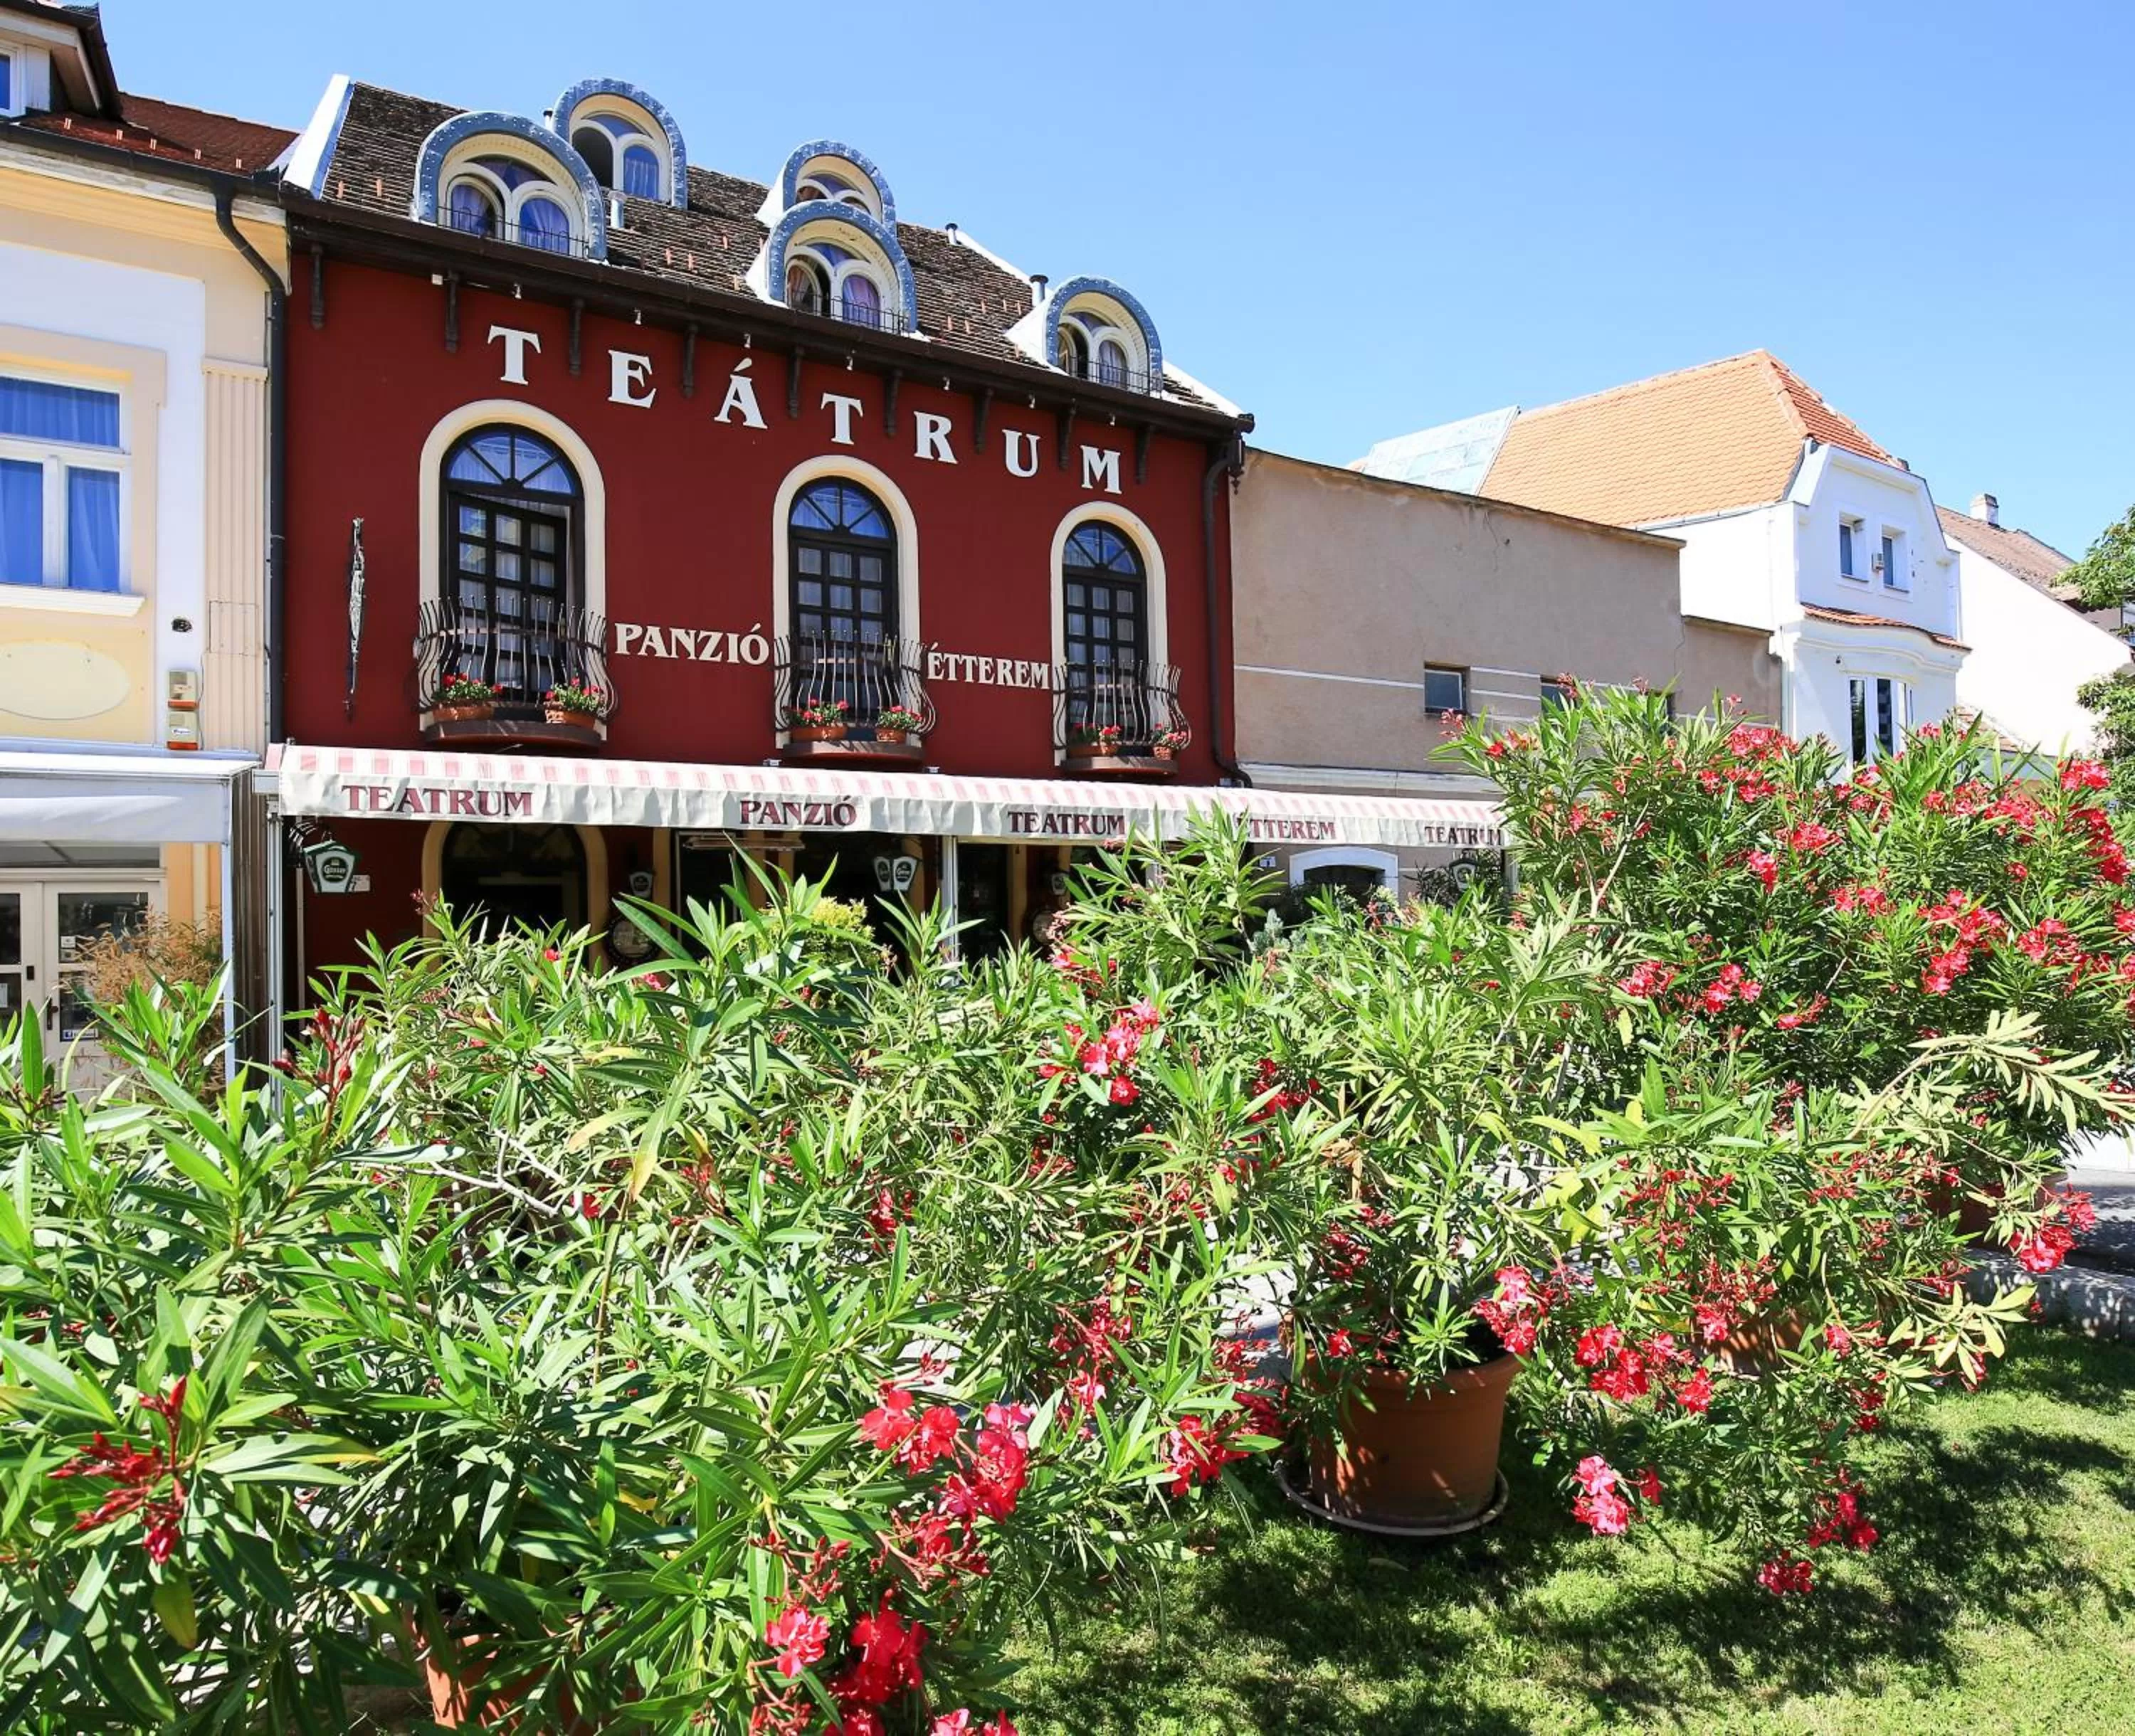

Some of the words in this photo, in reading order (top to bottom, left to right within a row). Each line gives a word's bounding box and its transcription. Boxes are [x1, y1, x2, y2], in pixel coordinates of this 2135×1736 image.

[487, 324, 1122, 494] TEÁTRUM
[614, 623, 770, 665] PANZIÓ
[927, 642, 1050, 689] ÉTTEREM
[341, 785, 534, 816] TEATRUM
[739, 795, 857, 826] PANZIÓ
[1008, 811, 1125, 835] TEATRUM
[1424, 826, 1502, 846] TEATRUM
